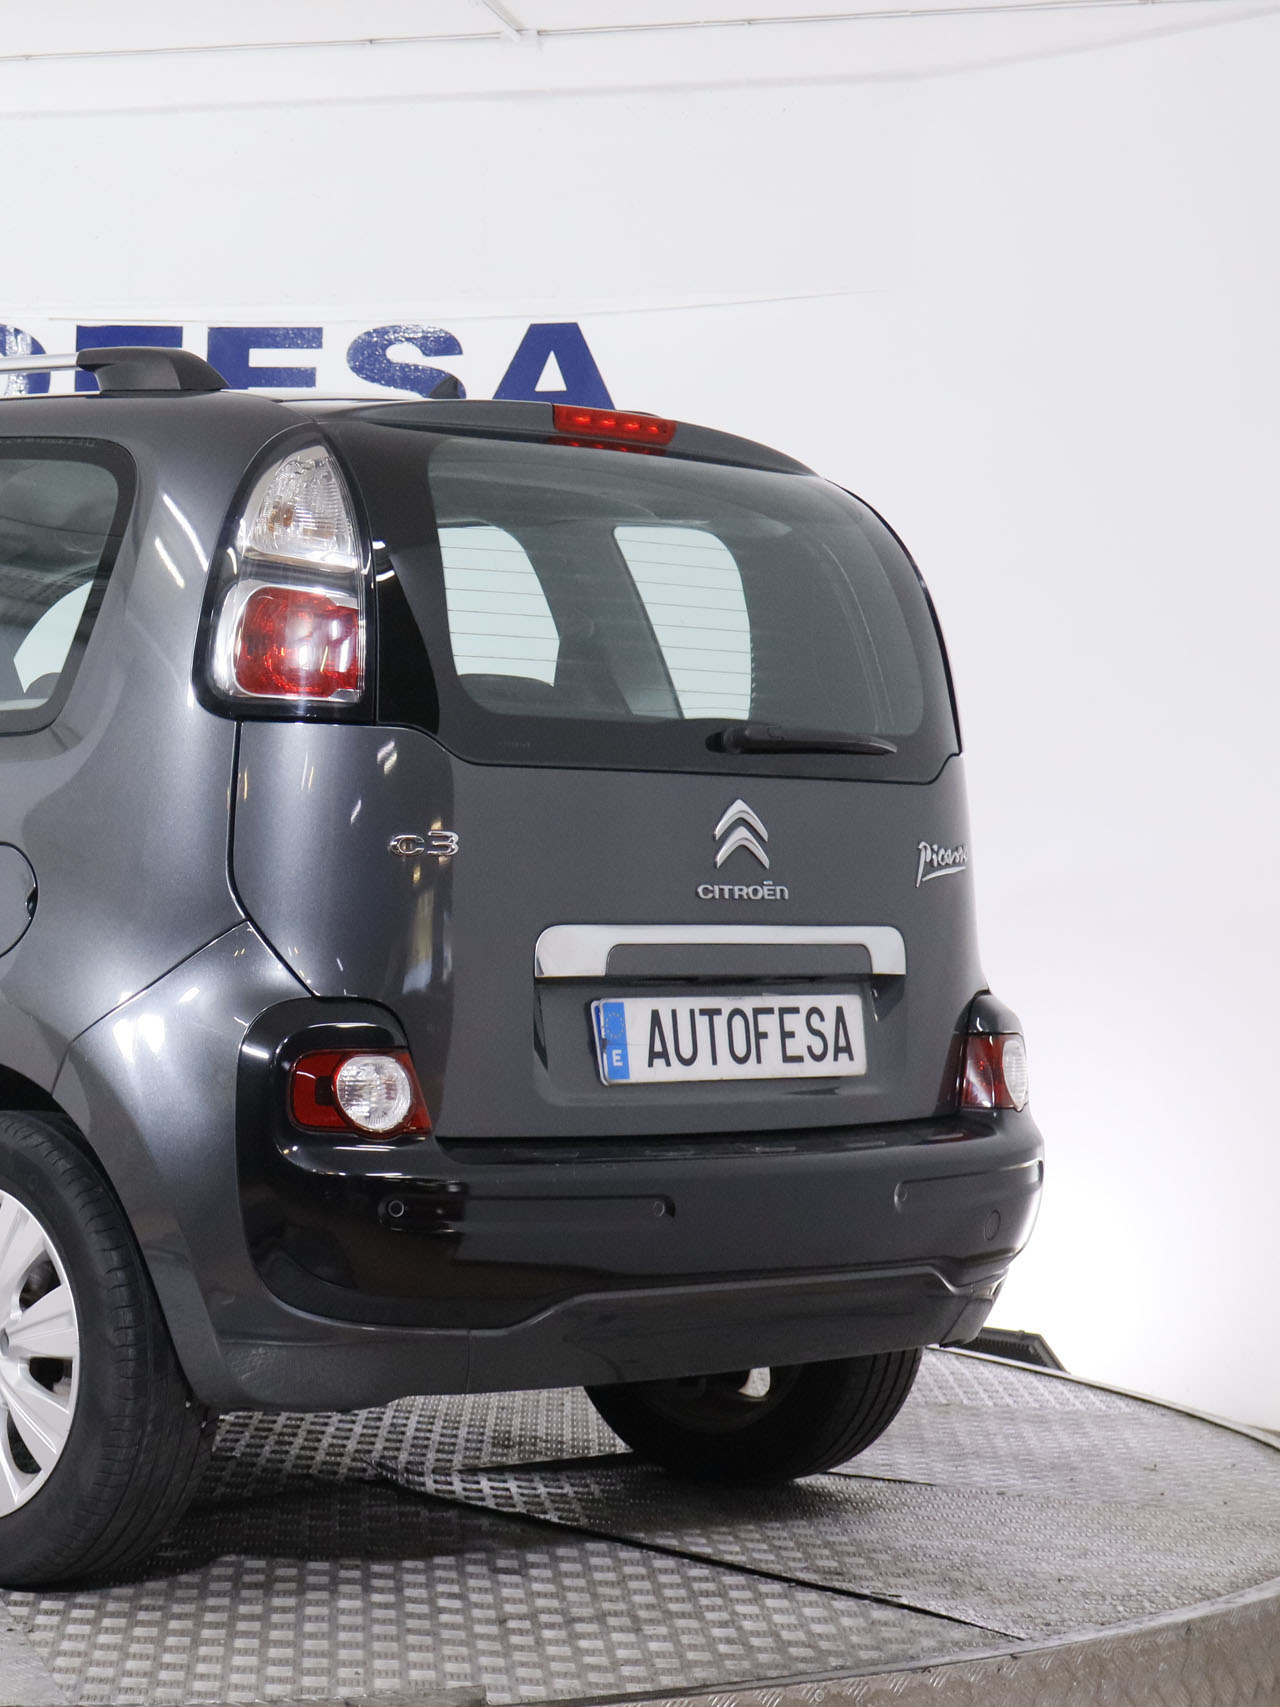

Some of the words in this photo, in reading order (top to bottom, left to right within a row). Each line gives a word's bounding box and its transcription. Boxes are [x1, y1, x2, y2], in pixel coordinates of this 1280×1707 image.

[389, 831, 459, 856] C3
[647, 1006, 854, 1068] AUTOFESA
[612, 1049, 624, 1067] E
